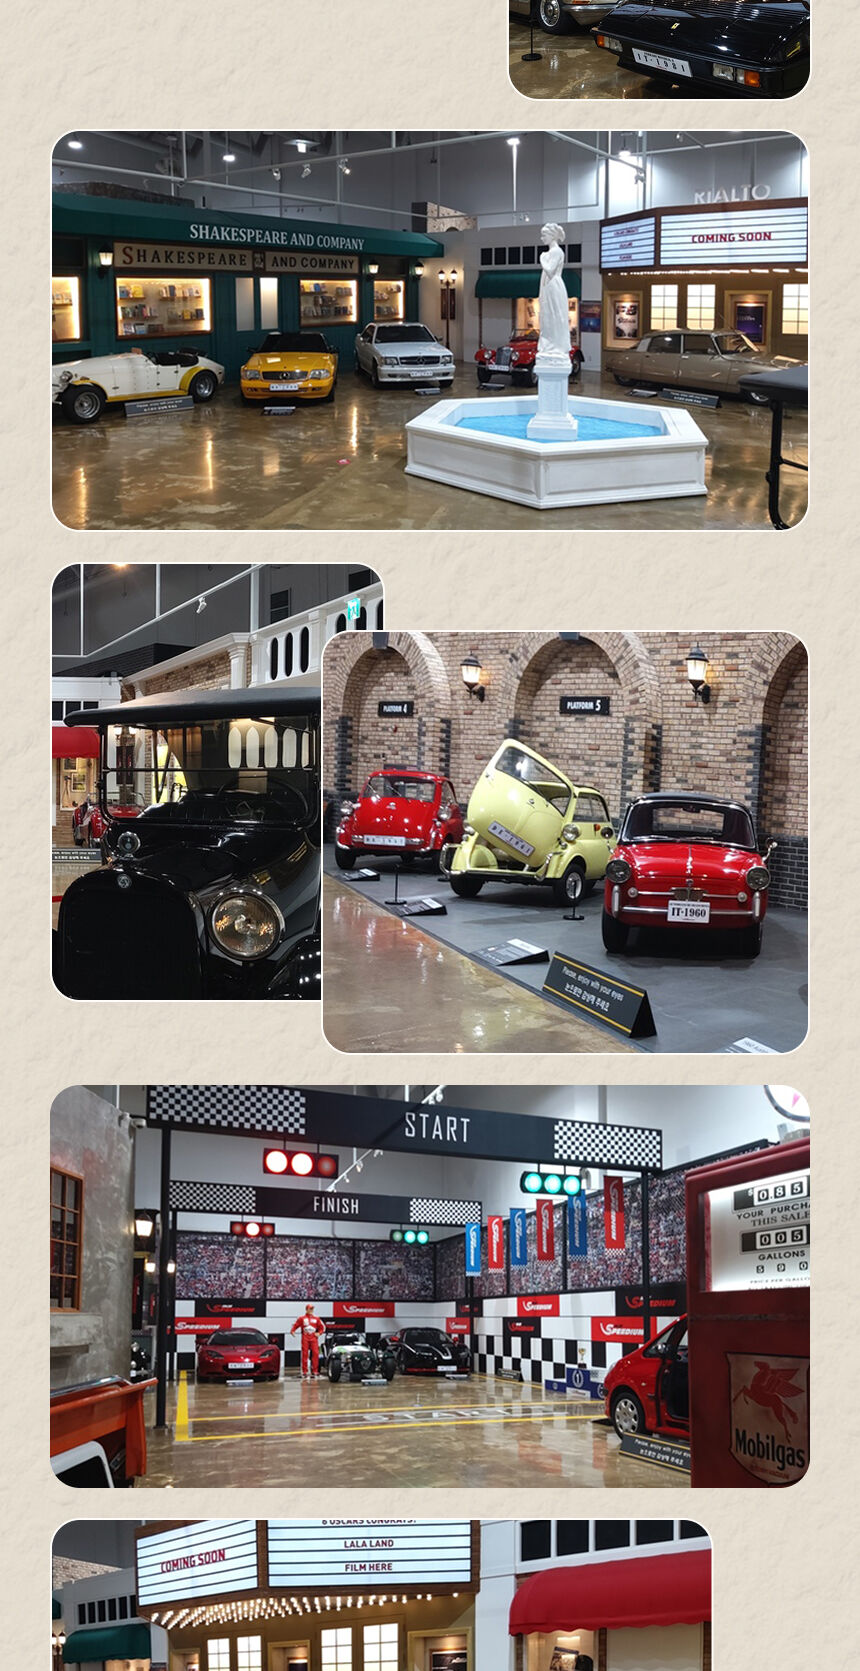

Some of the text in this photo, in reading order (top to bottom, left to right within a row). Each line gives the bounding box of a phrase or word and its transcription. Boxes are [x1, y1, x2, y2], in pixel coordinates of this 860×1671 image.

[694, 184, 771, 204] RIALTO
[190, 224, 364, 250] SHAKESPEARE AND COMPANY
[691, 231, 772, 244] COMING SOON
[122, 246, 354, 269] SHAKESPEARE AND COMPANY
[567, 700, 601, 711] PLATFORM 5
[671, 907, 707, 918] IT-1960
[405, 1112, 470, 1142] START
[313, 1196, 359, 1214] FINISH
[737, 1210, 764, 1220] YOUR
[751, 1216, 777, 1227] THIS
[758, 1250, 806, 1261] GALLONS
[735, 1428, 806, 1470] Mobilgas
[344, 1539, 394, 1548] LALA LAND
[160, 1549, 226, 1573] COMING SOON
[345, 1563, 393, 1572] FILM HERE
